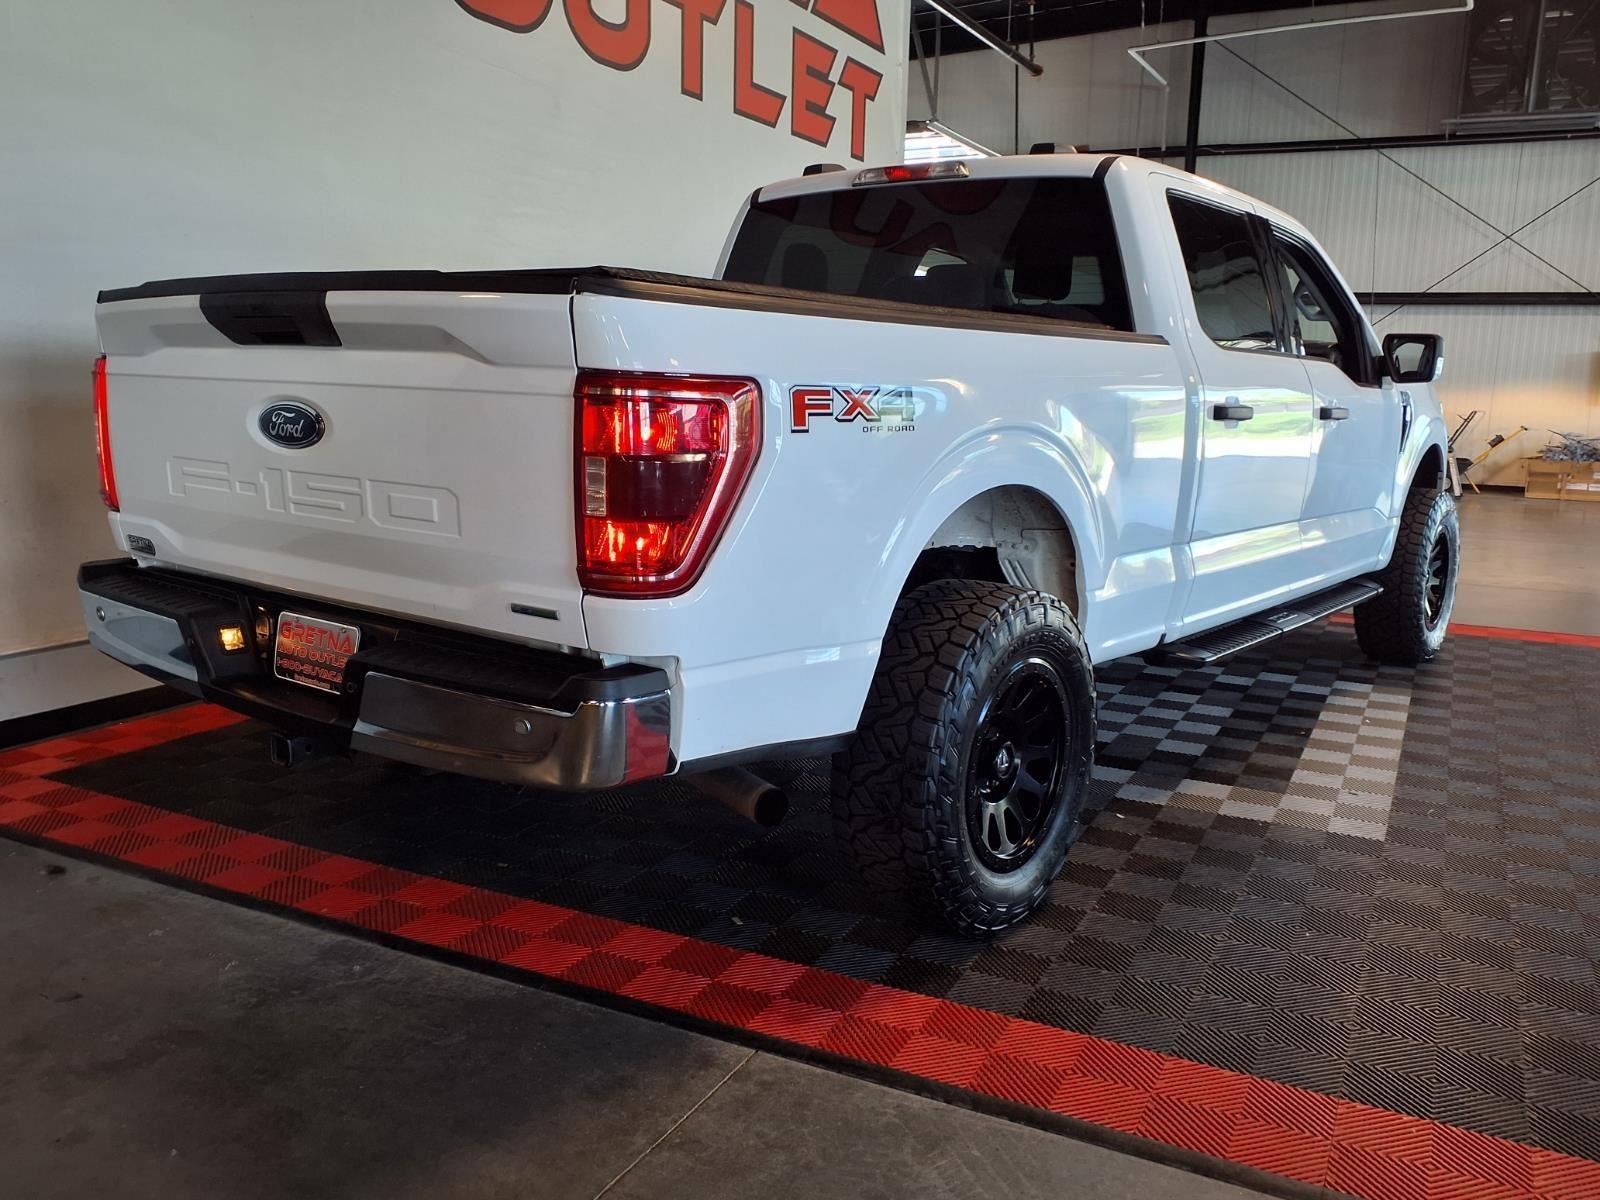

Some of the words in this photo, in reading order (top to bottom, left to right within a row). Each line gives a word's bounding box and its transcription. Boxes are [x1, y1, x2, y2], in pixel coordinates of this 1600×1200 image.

[453, 0, 884, 162] UTLET
[269, 409, 304, 438] Ford
[788, 384, 914, 434] FX4
[862, 425, 883, 433] OFF
[888, 424, 915, 433] ROAD
[166, 455, 462, 539] F-150
[278, 640, 308, 657] AUTO
[309, 649, 346, 668] OUTLE
[281, 620, 353, 655] GRETNA
